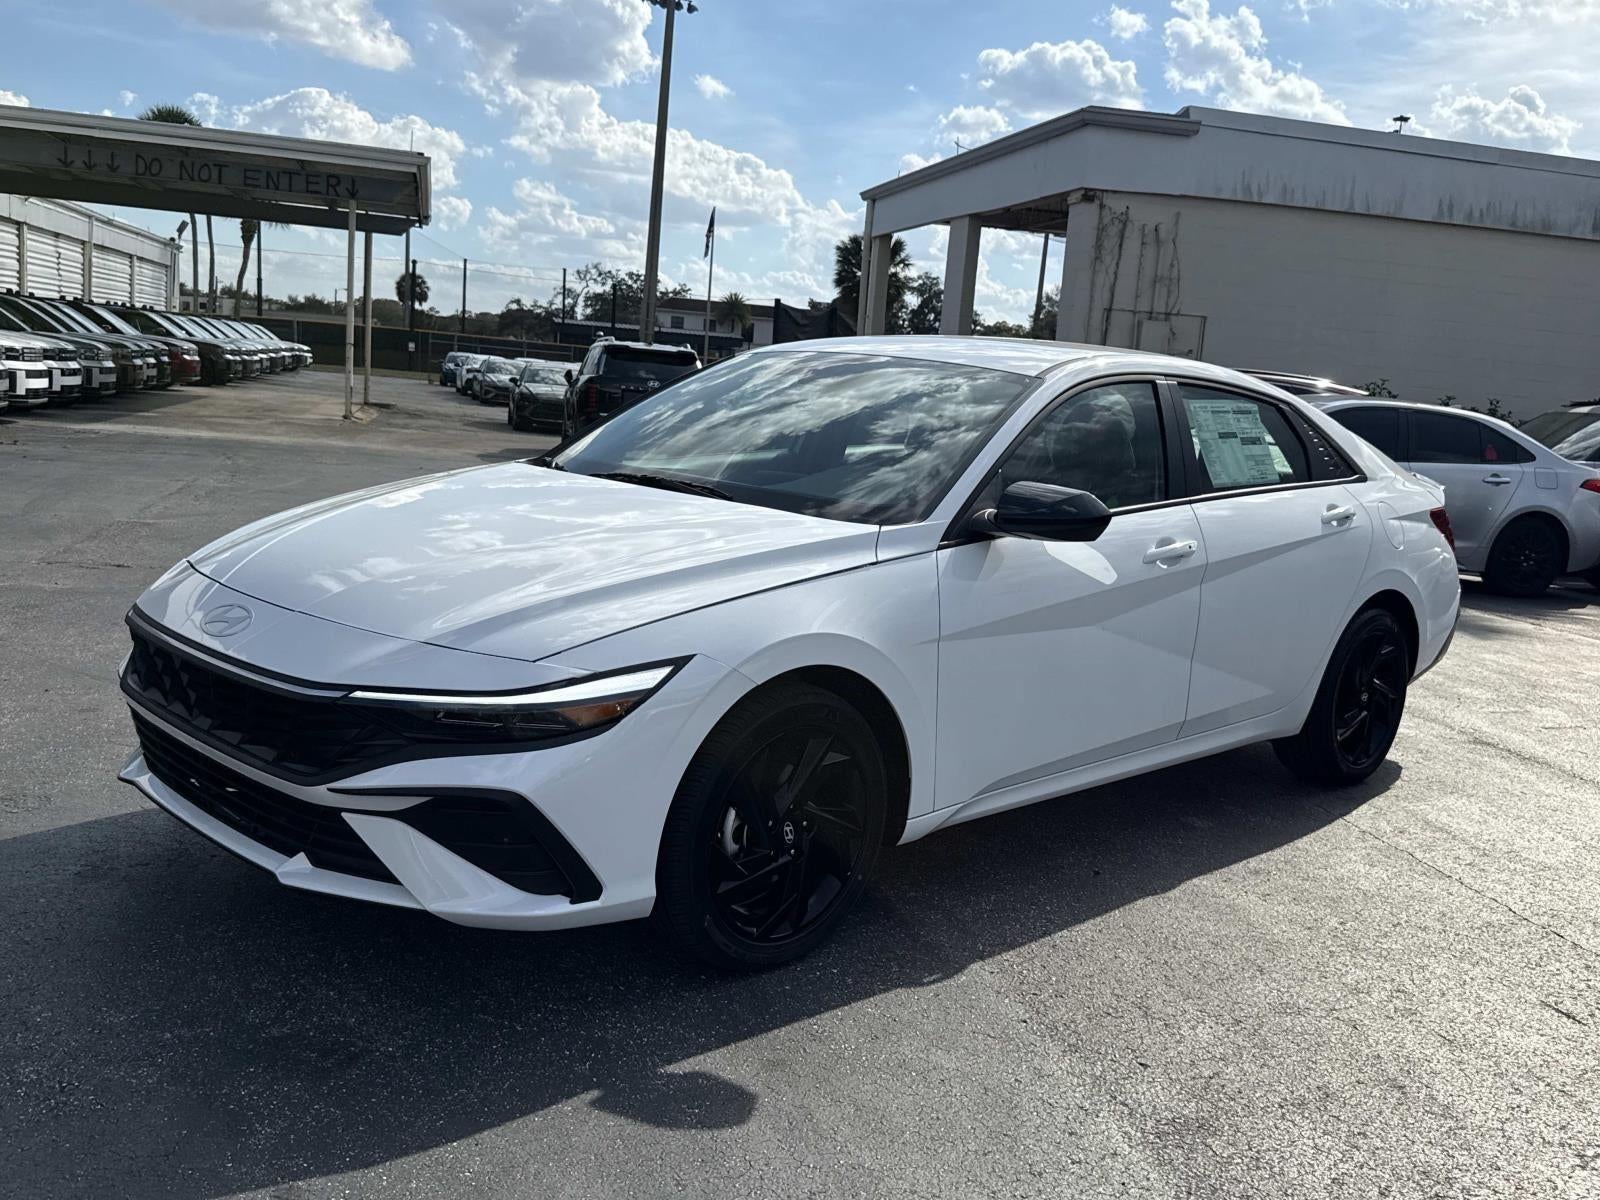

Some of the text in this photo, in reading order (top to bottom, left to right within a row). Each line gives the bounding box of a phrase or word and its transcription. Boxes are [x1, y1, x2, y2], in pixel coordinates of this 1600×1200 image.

[135, 153, 341, 197] DO NOT ENTER
